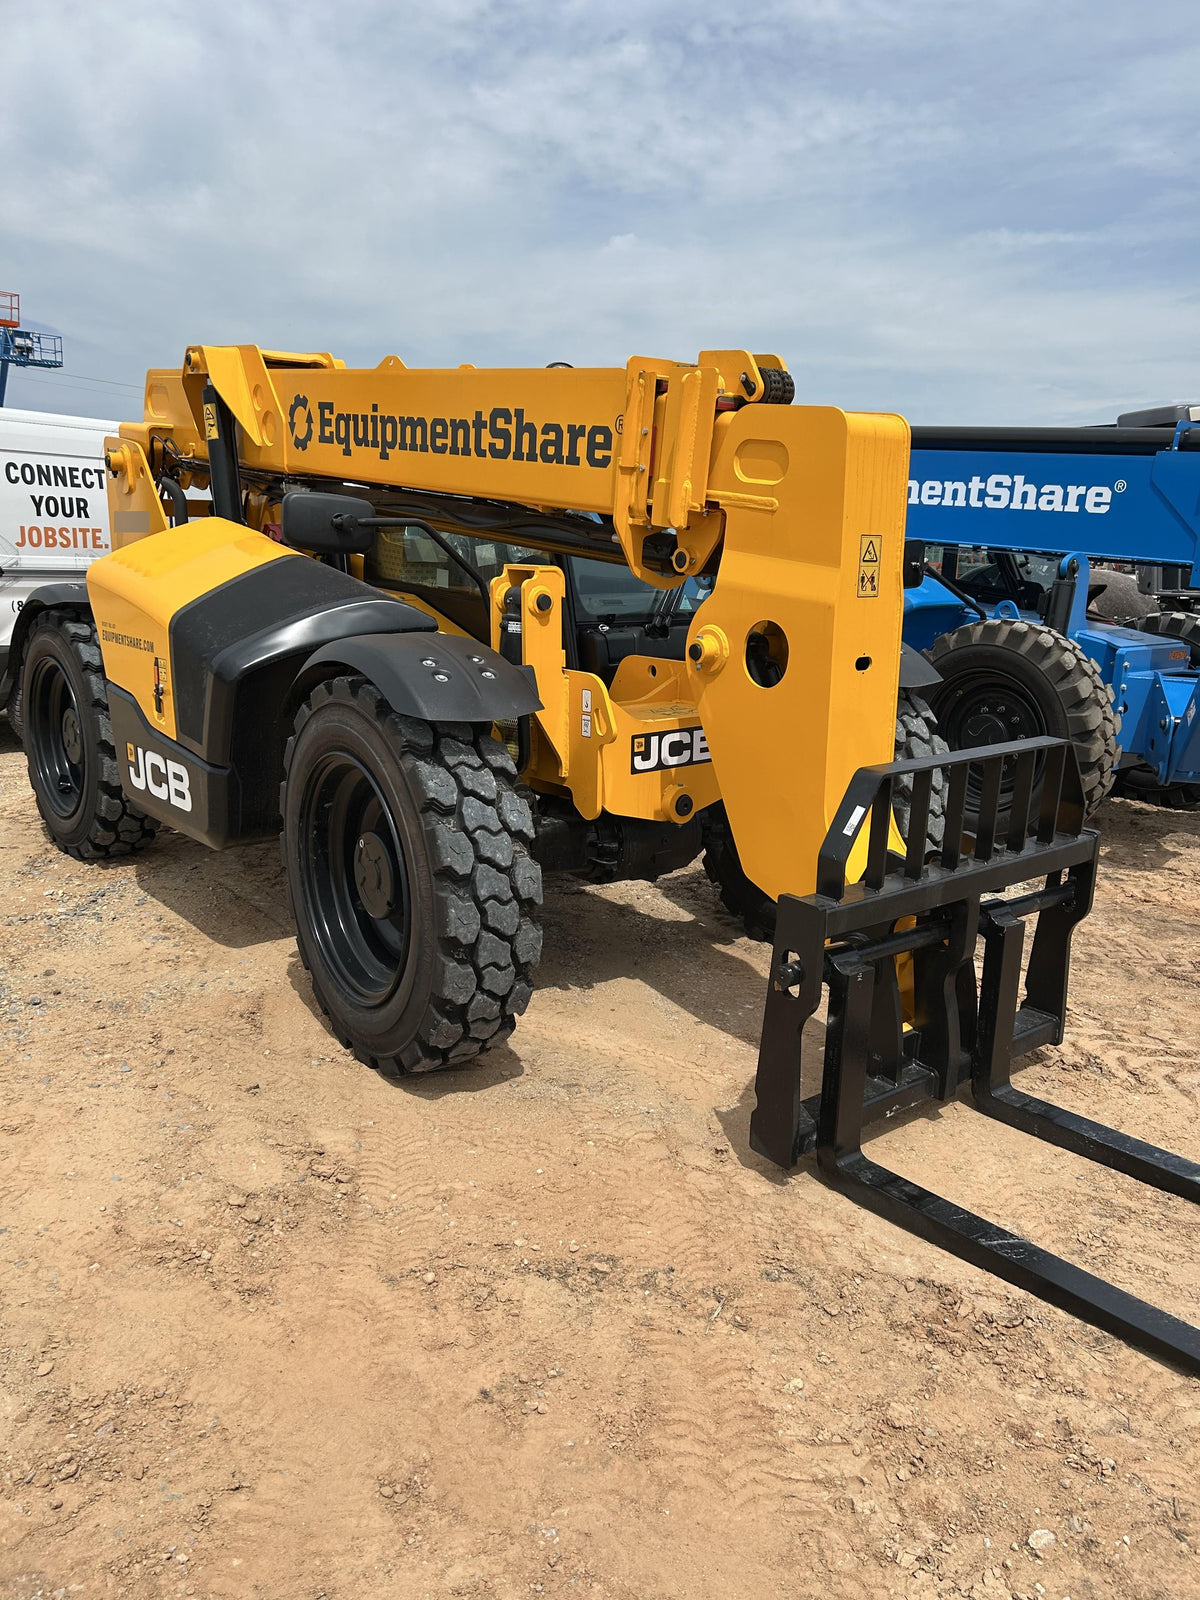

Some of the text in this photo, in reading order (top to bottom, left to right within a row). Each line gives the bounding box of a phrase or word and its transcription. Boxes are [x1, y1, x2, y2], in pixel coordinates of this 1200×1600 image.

[5, 461, 106, 490] CONNECT
[30, 494, 91, 519] YOUR
[15, 525, 110, 550] JOBSITE.
[129, 746, 192, 812] JCB
